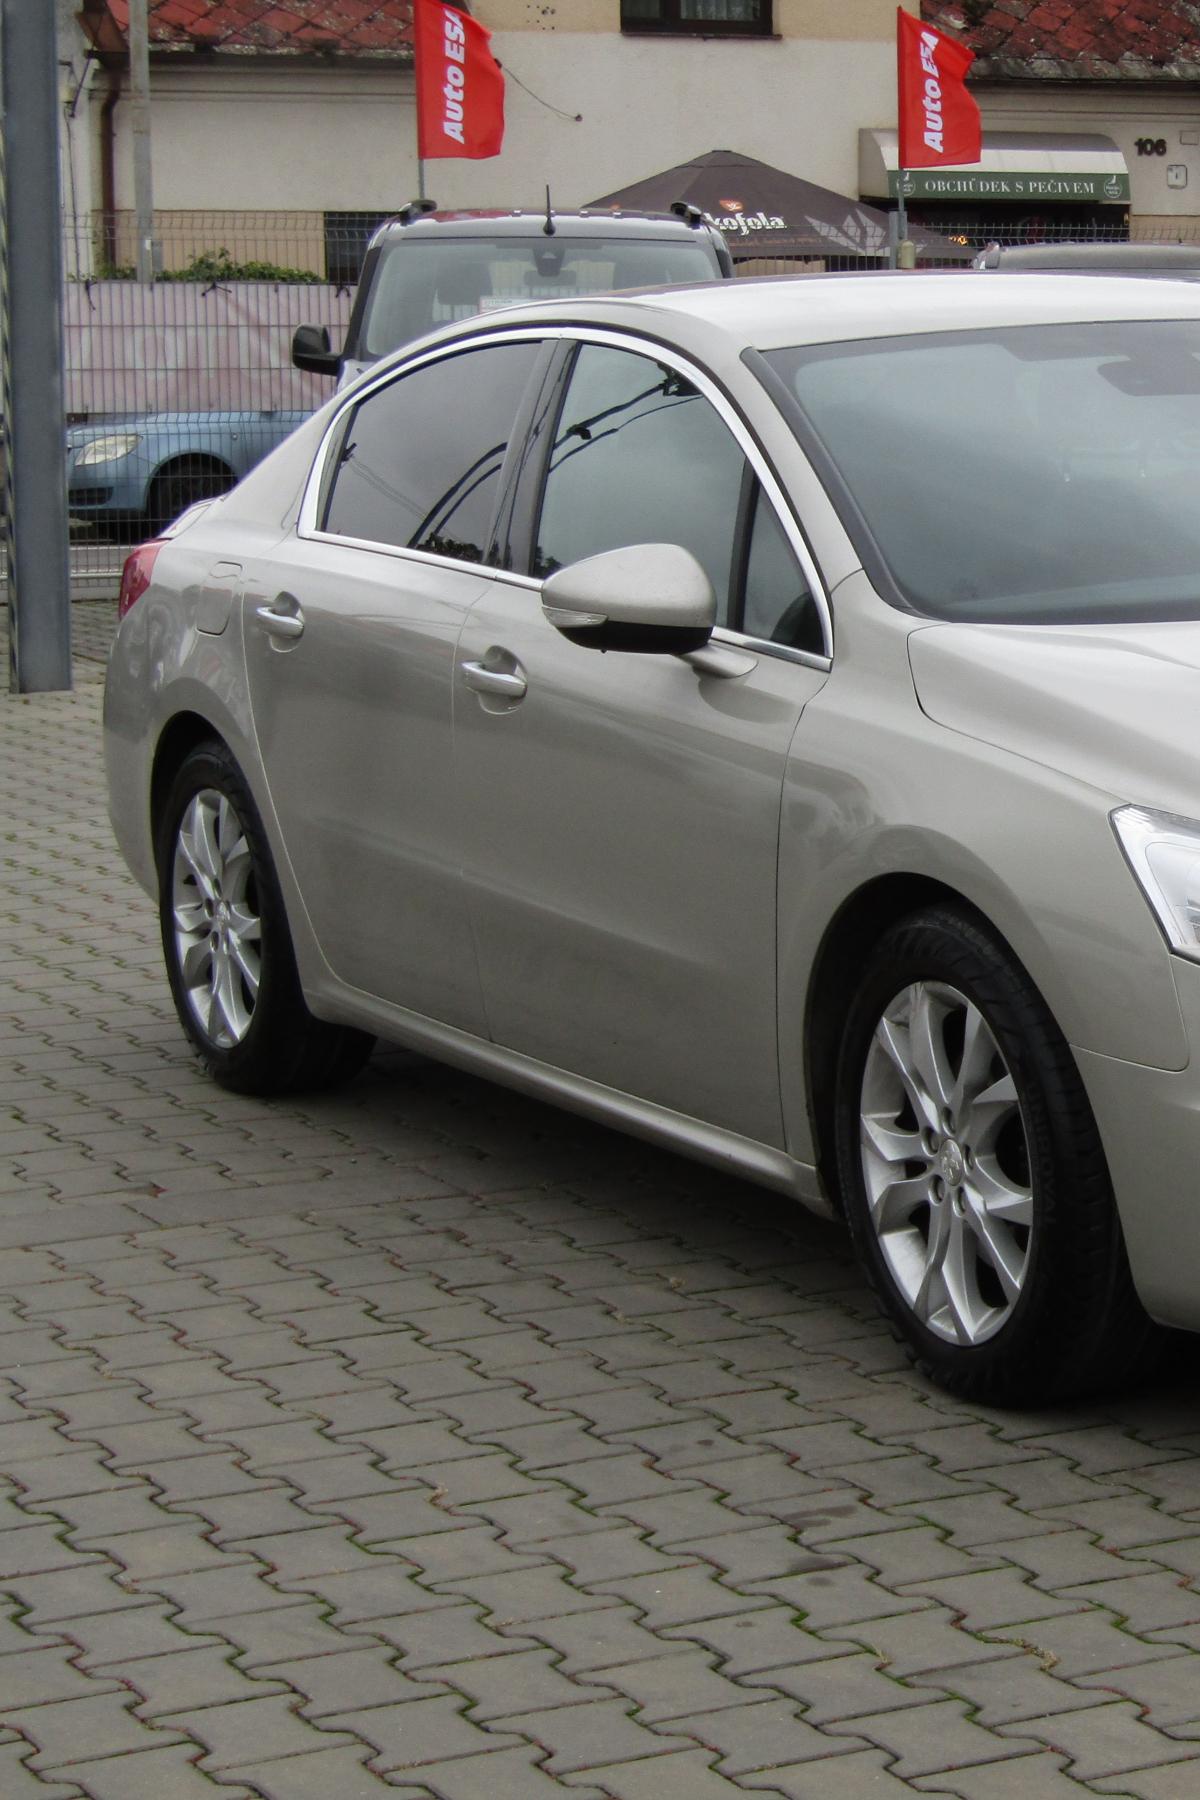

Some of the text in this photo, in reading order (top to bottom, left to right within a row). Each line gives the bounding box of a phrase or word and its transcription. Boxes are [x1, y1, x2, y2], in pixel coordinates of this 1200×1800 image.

[443, 64, 465, 145] Auto
[922, 78, 944, 153] Auto
[1134, 138, 1167, 156] 106
[924, 177, 1010, 193] OBCHŮDEK
[1015, 180, 1024, 193] S
[1029, 179, 1095, 194] PEČIVEM
